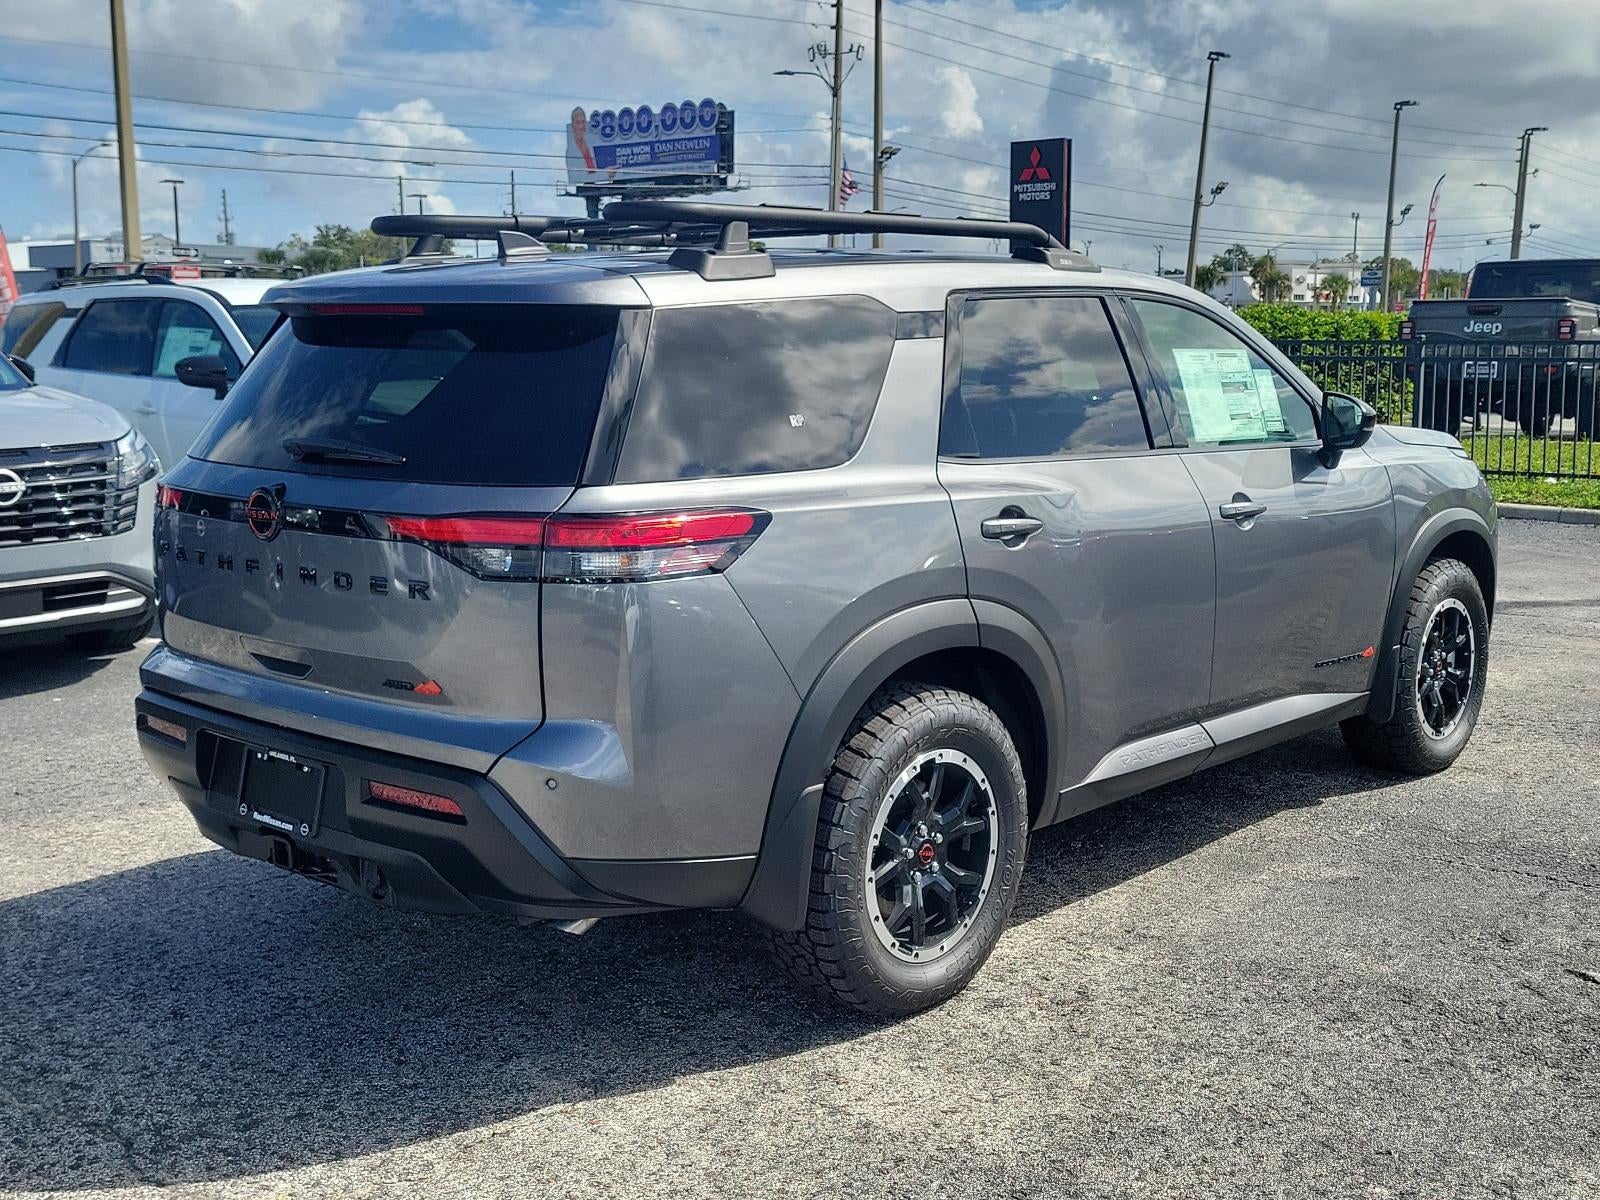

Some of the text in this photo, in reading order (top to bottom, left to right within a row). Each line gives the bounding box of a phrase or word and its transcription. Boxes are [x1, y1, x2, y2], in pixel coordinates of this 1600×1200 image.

[590, 98, 718, 141] $800,000
[1013, 182, 1056, 192] MITSUBISHI
[1019, 191, 1050, 201] MOTORS
[1463, 320, 1502, 334] Jeep
[159, 542, 432, 601] PATHFINDER
[1119, 733, 1209, 767] PATHFINDER
[991, 848, 1017, 921] TOYO
